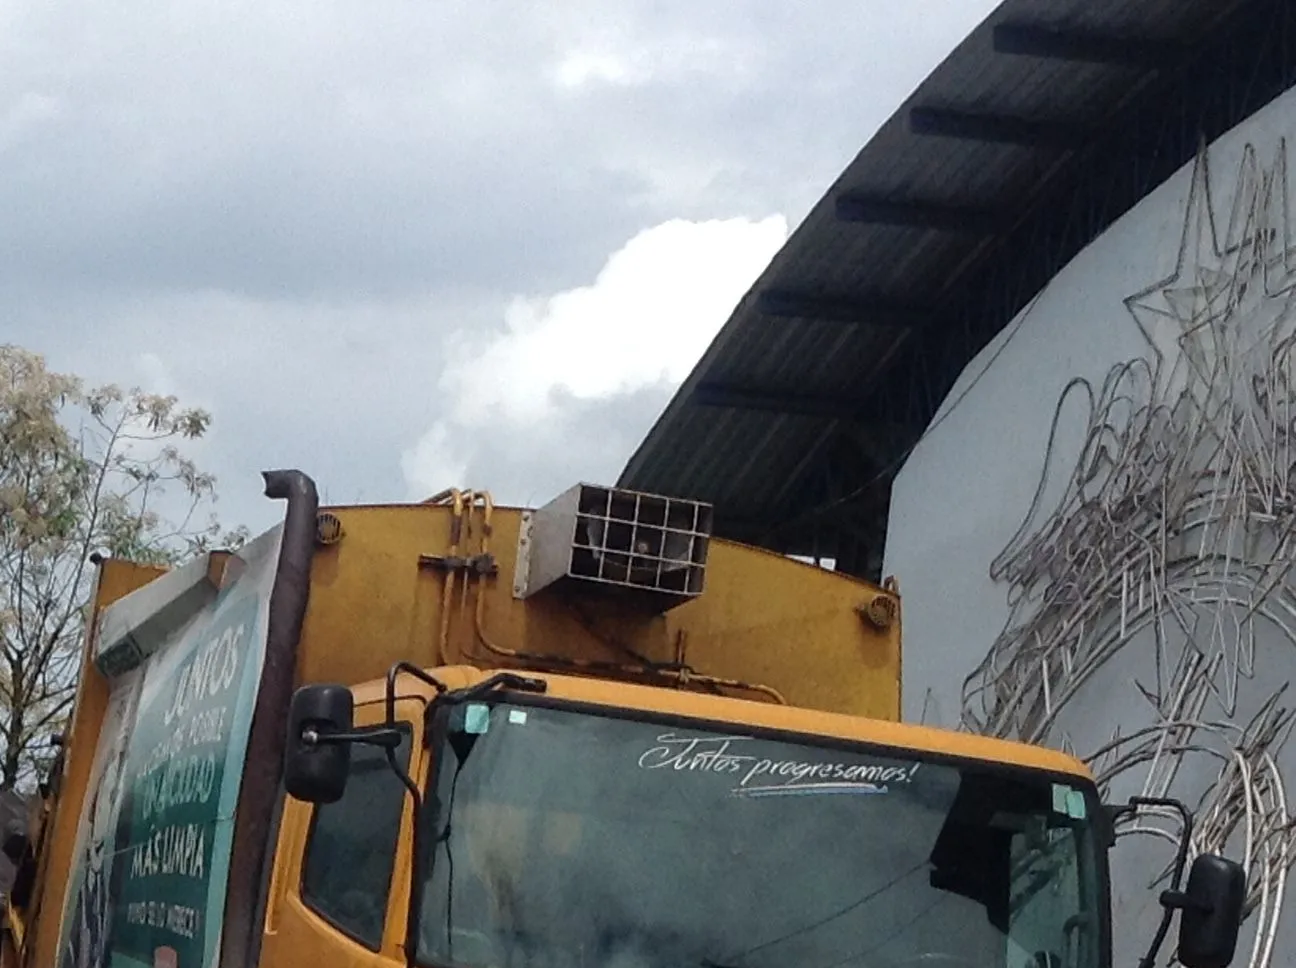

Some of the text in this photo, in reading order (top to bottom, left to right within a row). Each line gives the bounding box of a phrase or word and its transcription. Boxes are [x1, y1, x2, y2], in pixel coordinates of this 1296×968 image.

[164, 623, 244, 726] JUNTOS
[639, 733, 921, 786] Juntos progresamos!
[162, 824, 204, 880] LIMPIA
